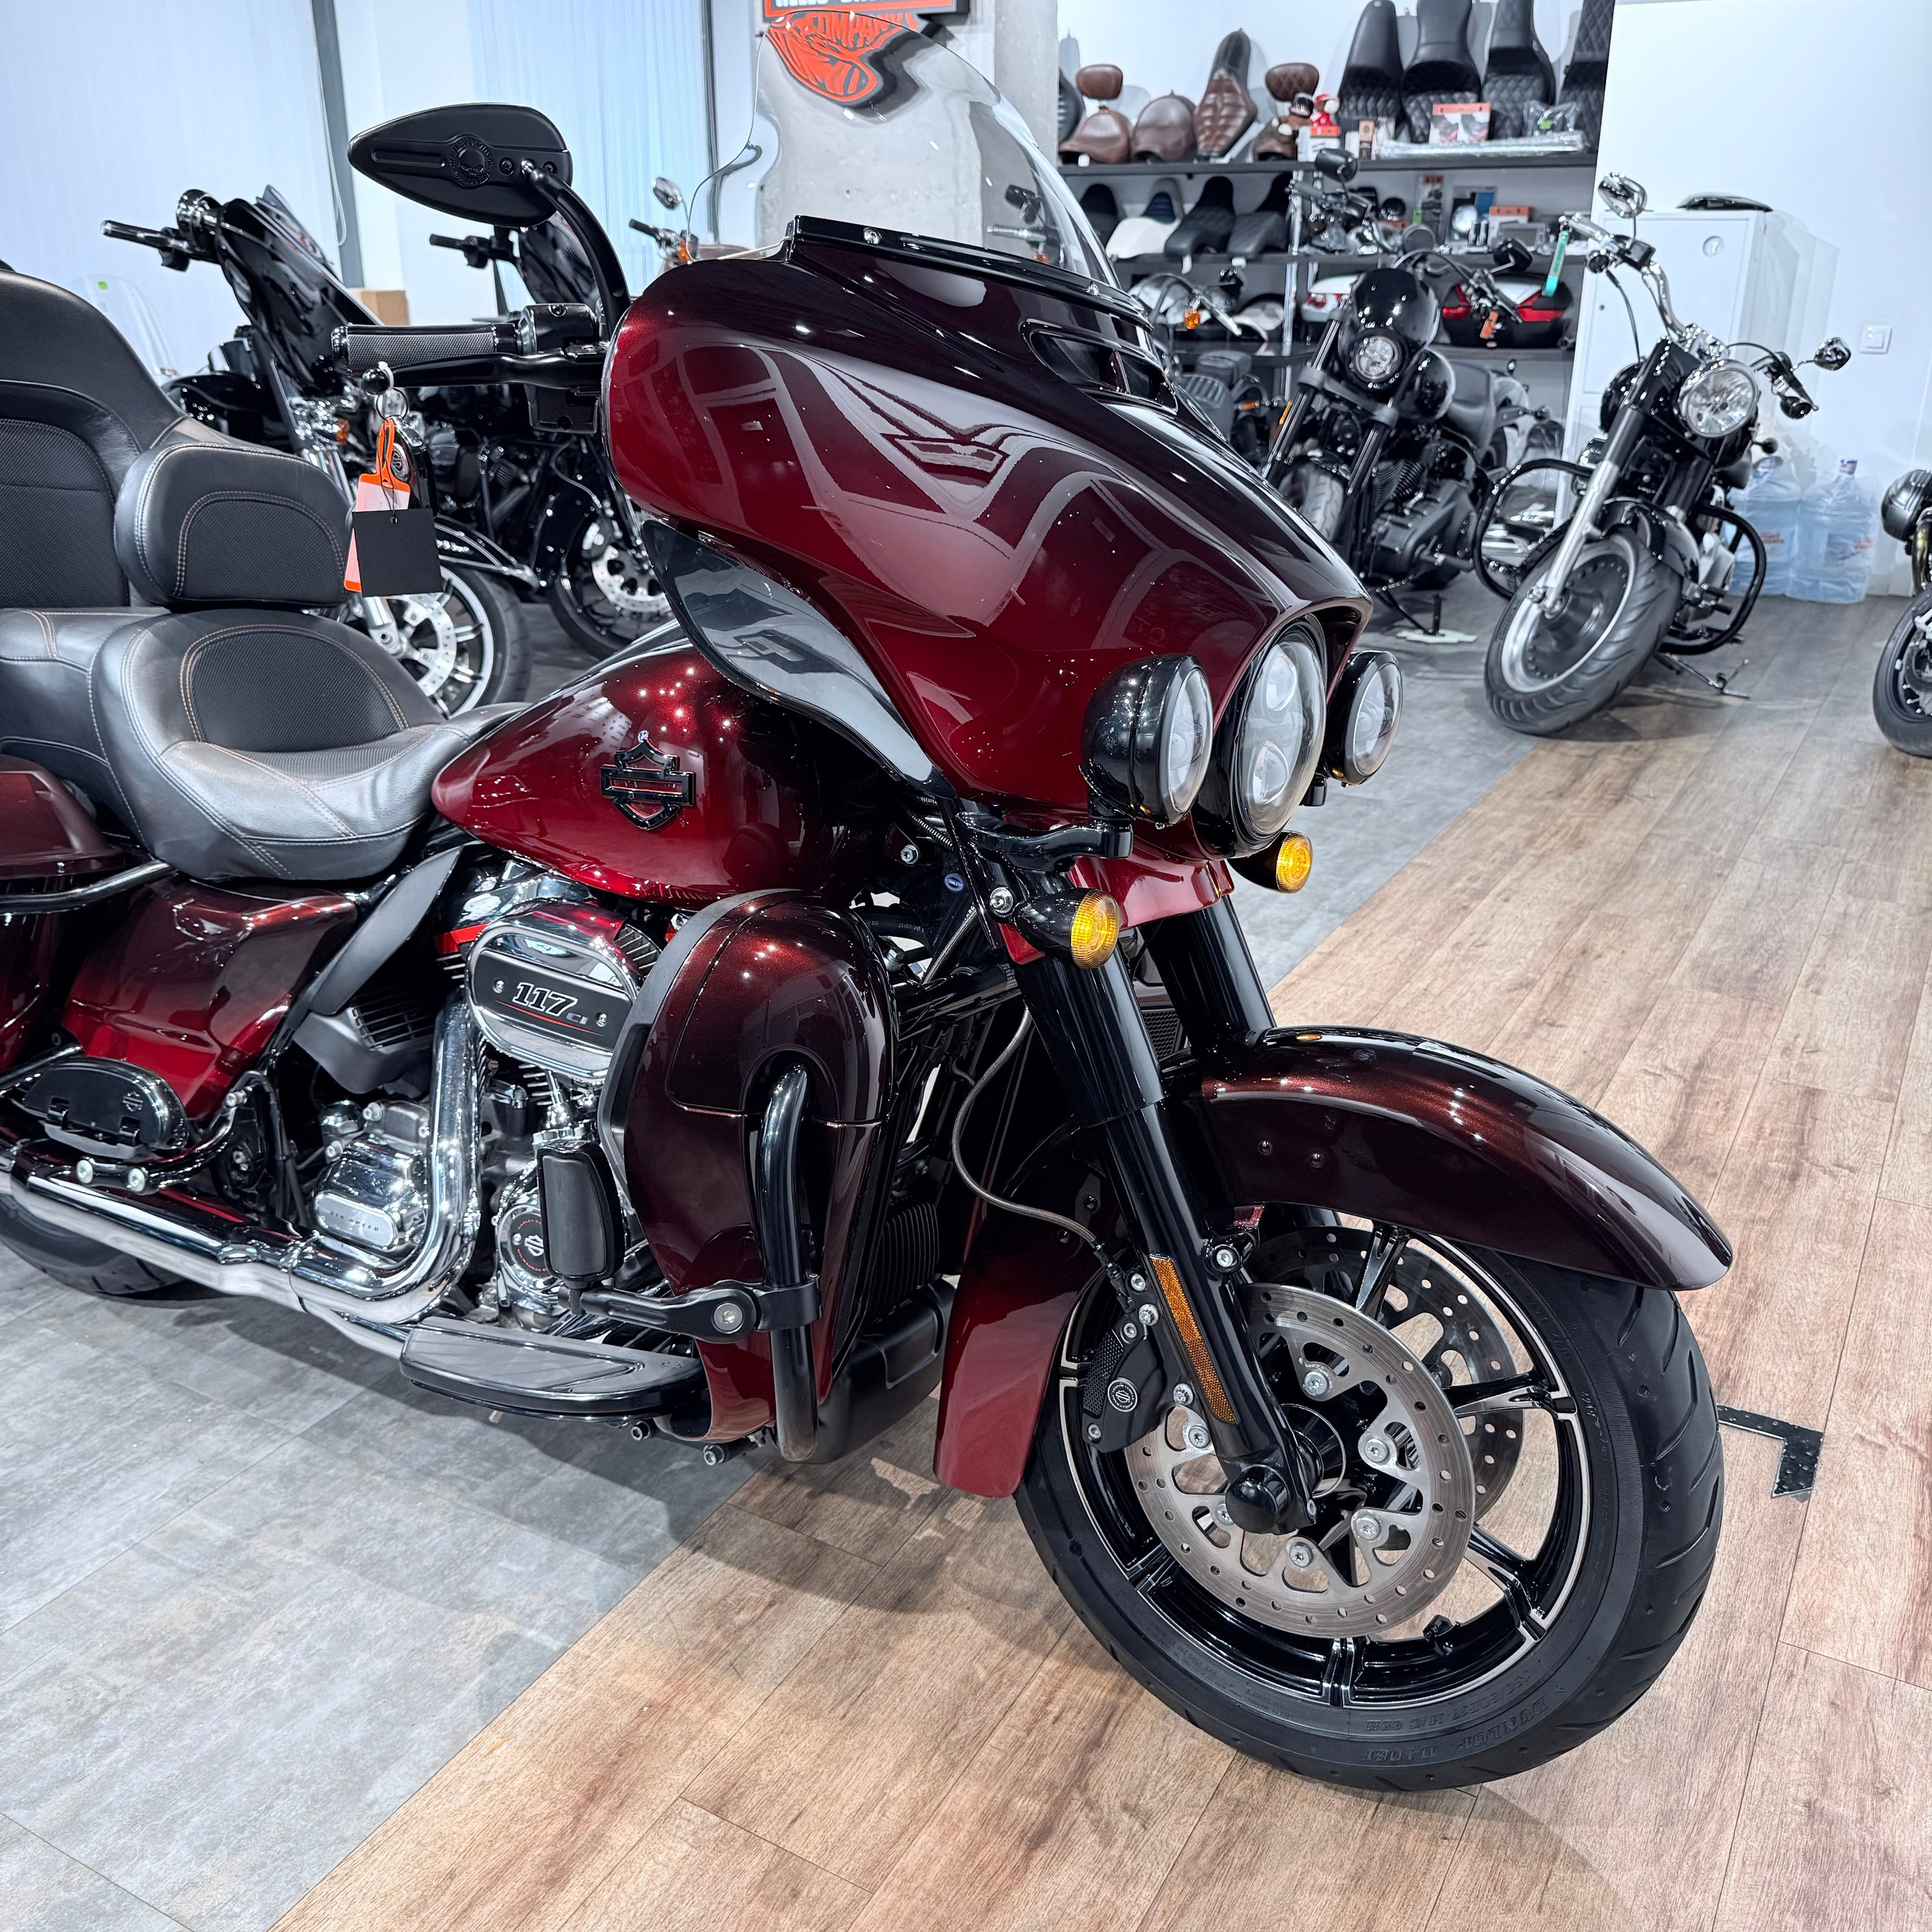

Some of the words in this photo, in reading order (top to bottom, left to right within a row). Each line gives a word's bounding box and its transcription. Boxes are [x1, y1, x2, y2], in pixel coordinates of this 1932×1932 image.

[512, 981, 579, 1017] 117
[566, 1012, 590, 1026] CI
[1457, 1697, 1549, 1752] DUNLOP
